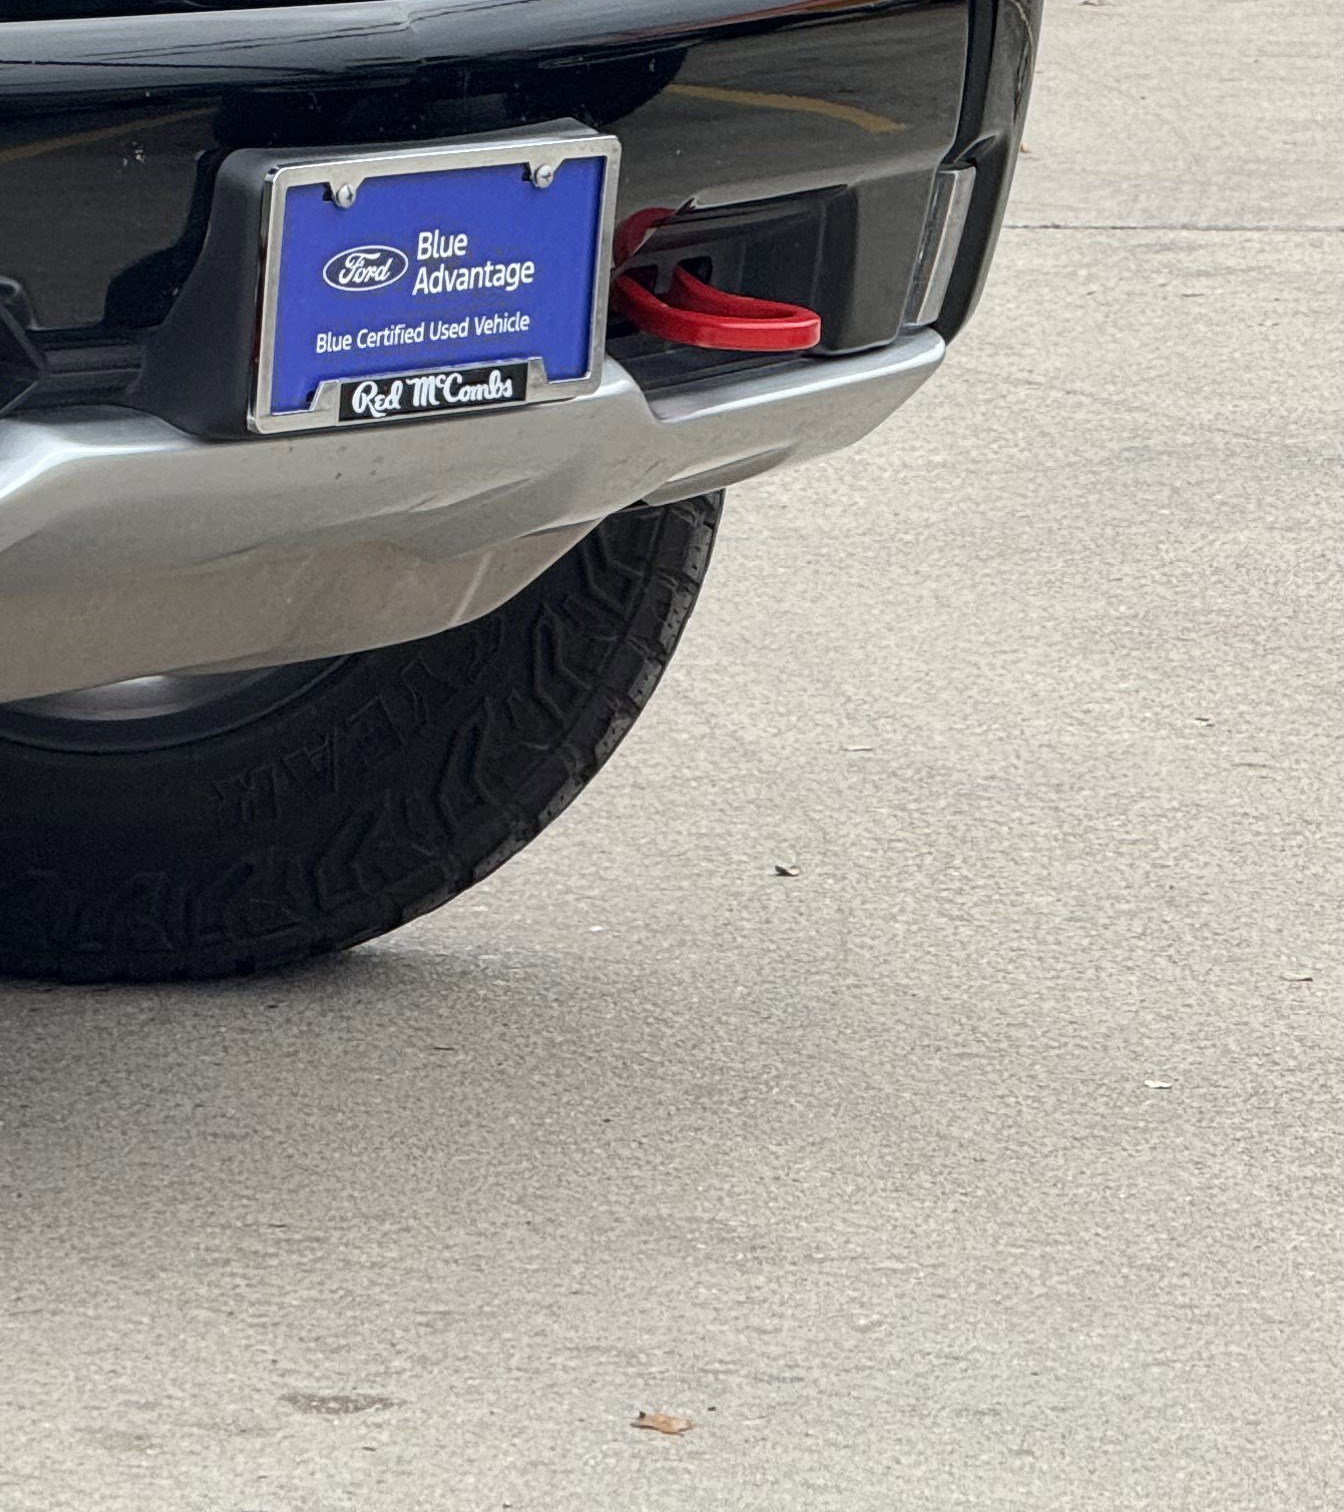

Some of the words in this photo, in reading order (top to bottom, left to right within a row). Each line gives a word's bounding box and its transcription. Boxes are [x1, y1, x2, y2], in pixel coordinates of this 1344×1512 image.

[415, 229, 469, 260] Blue
[339, 252, 391, 284] Ford
[412, 259, 535, 296] Advantage
[316, 332, 353, 354] Blue
[357, 322, 425, 348] Certified
[429, 318, 469, 342] Used
[475, 311, 531, 336] Vehicle
[352, 381, 402, 418] Red
[407, 369, 513, 407] McCombs
